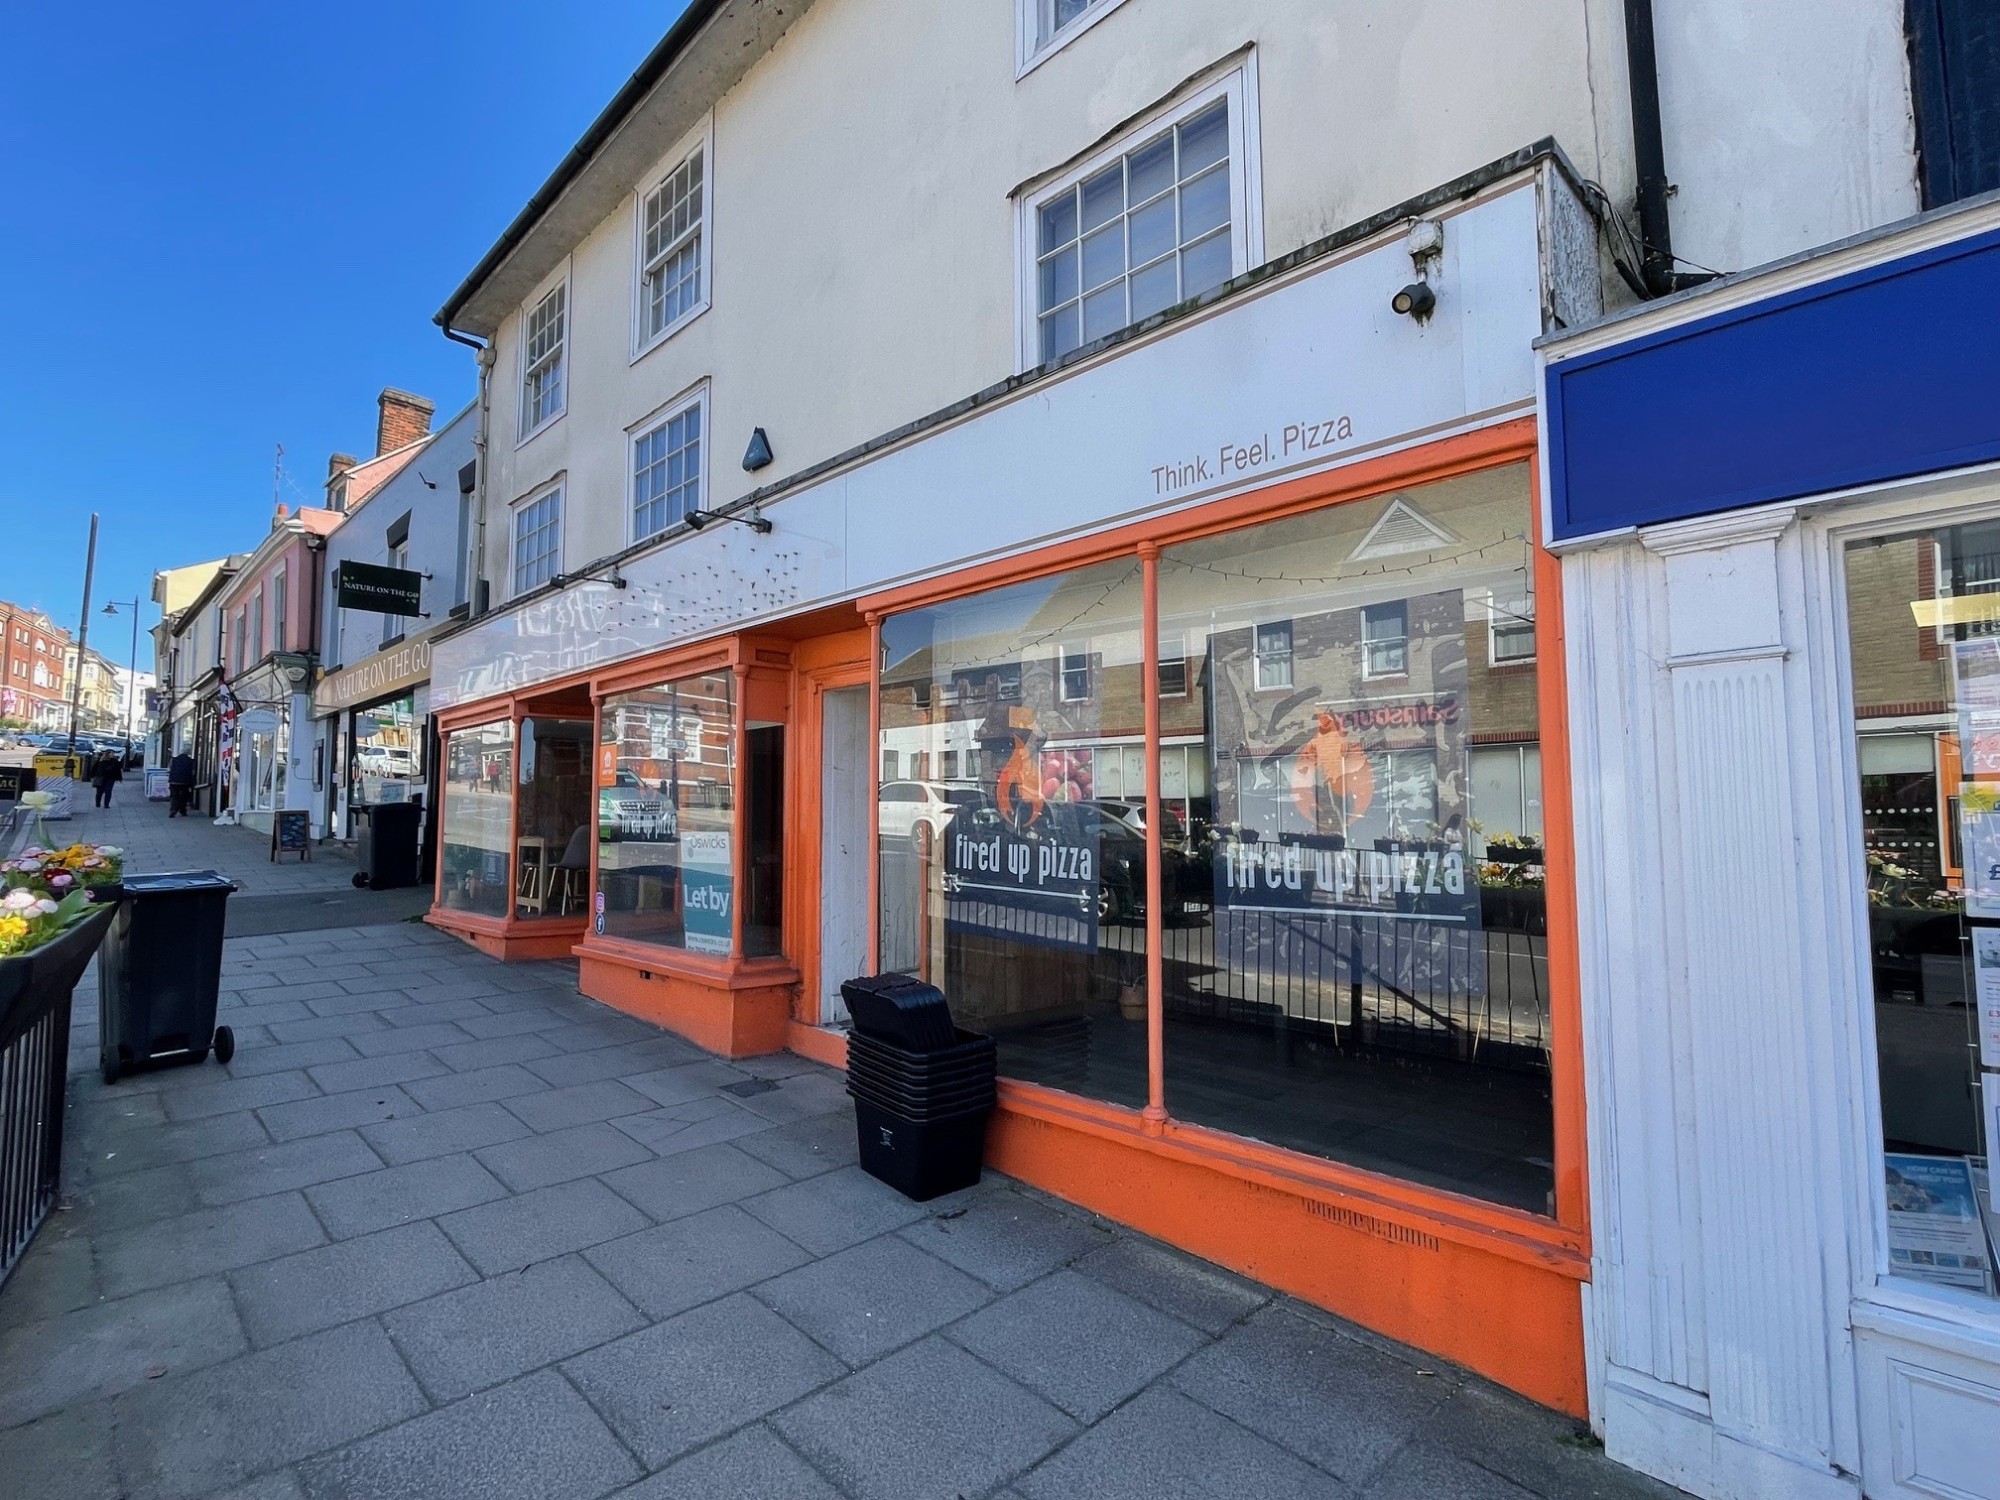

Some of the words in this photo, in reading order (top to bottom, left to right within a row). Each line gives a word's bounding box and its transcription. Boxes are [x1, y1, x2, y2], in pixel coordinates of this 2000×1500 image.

[1151, 455, 1214, 495] Think.
[1219, 433, 1276, 475] Feel.
[1283, 415, 1353, 456] Pizza
[344, 582, 376, 592] NATURE
[390, 588, 406, 597] THE
[335, 667, 370, 702] NATURE
[370, 659, 386, 689] ON
[387, 648, 410, 682] THE
[411, 640, 431, 672] GO
[655, 812, 677, 840] pizza
[690, 835, 726, 849] Oswicks
[955, 834, 1000, 873] fired
[1008, 843, 1031, 883] up
[1038, 838, 1092, 885] pizza
[1226, 842, 1302, 891] fired
[1315, 851, 1354, 903] up
[1370, 843, 1465, 905] pizza
[684, 884, 708, 910] Let
[708, 885, 729, 918] by
